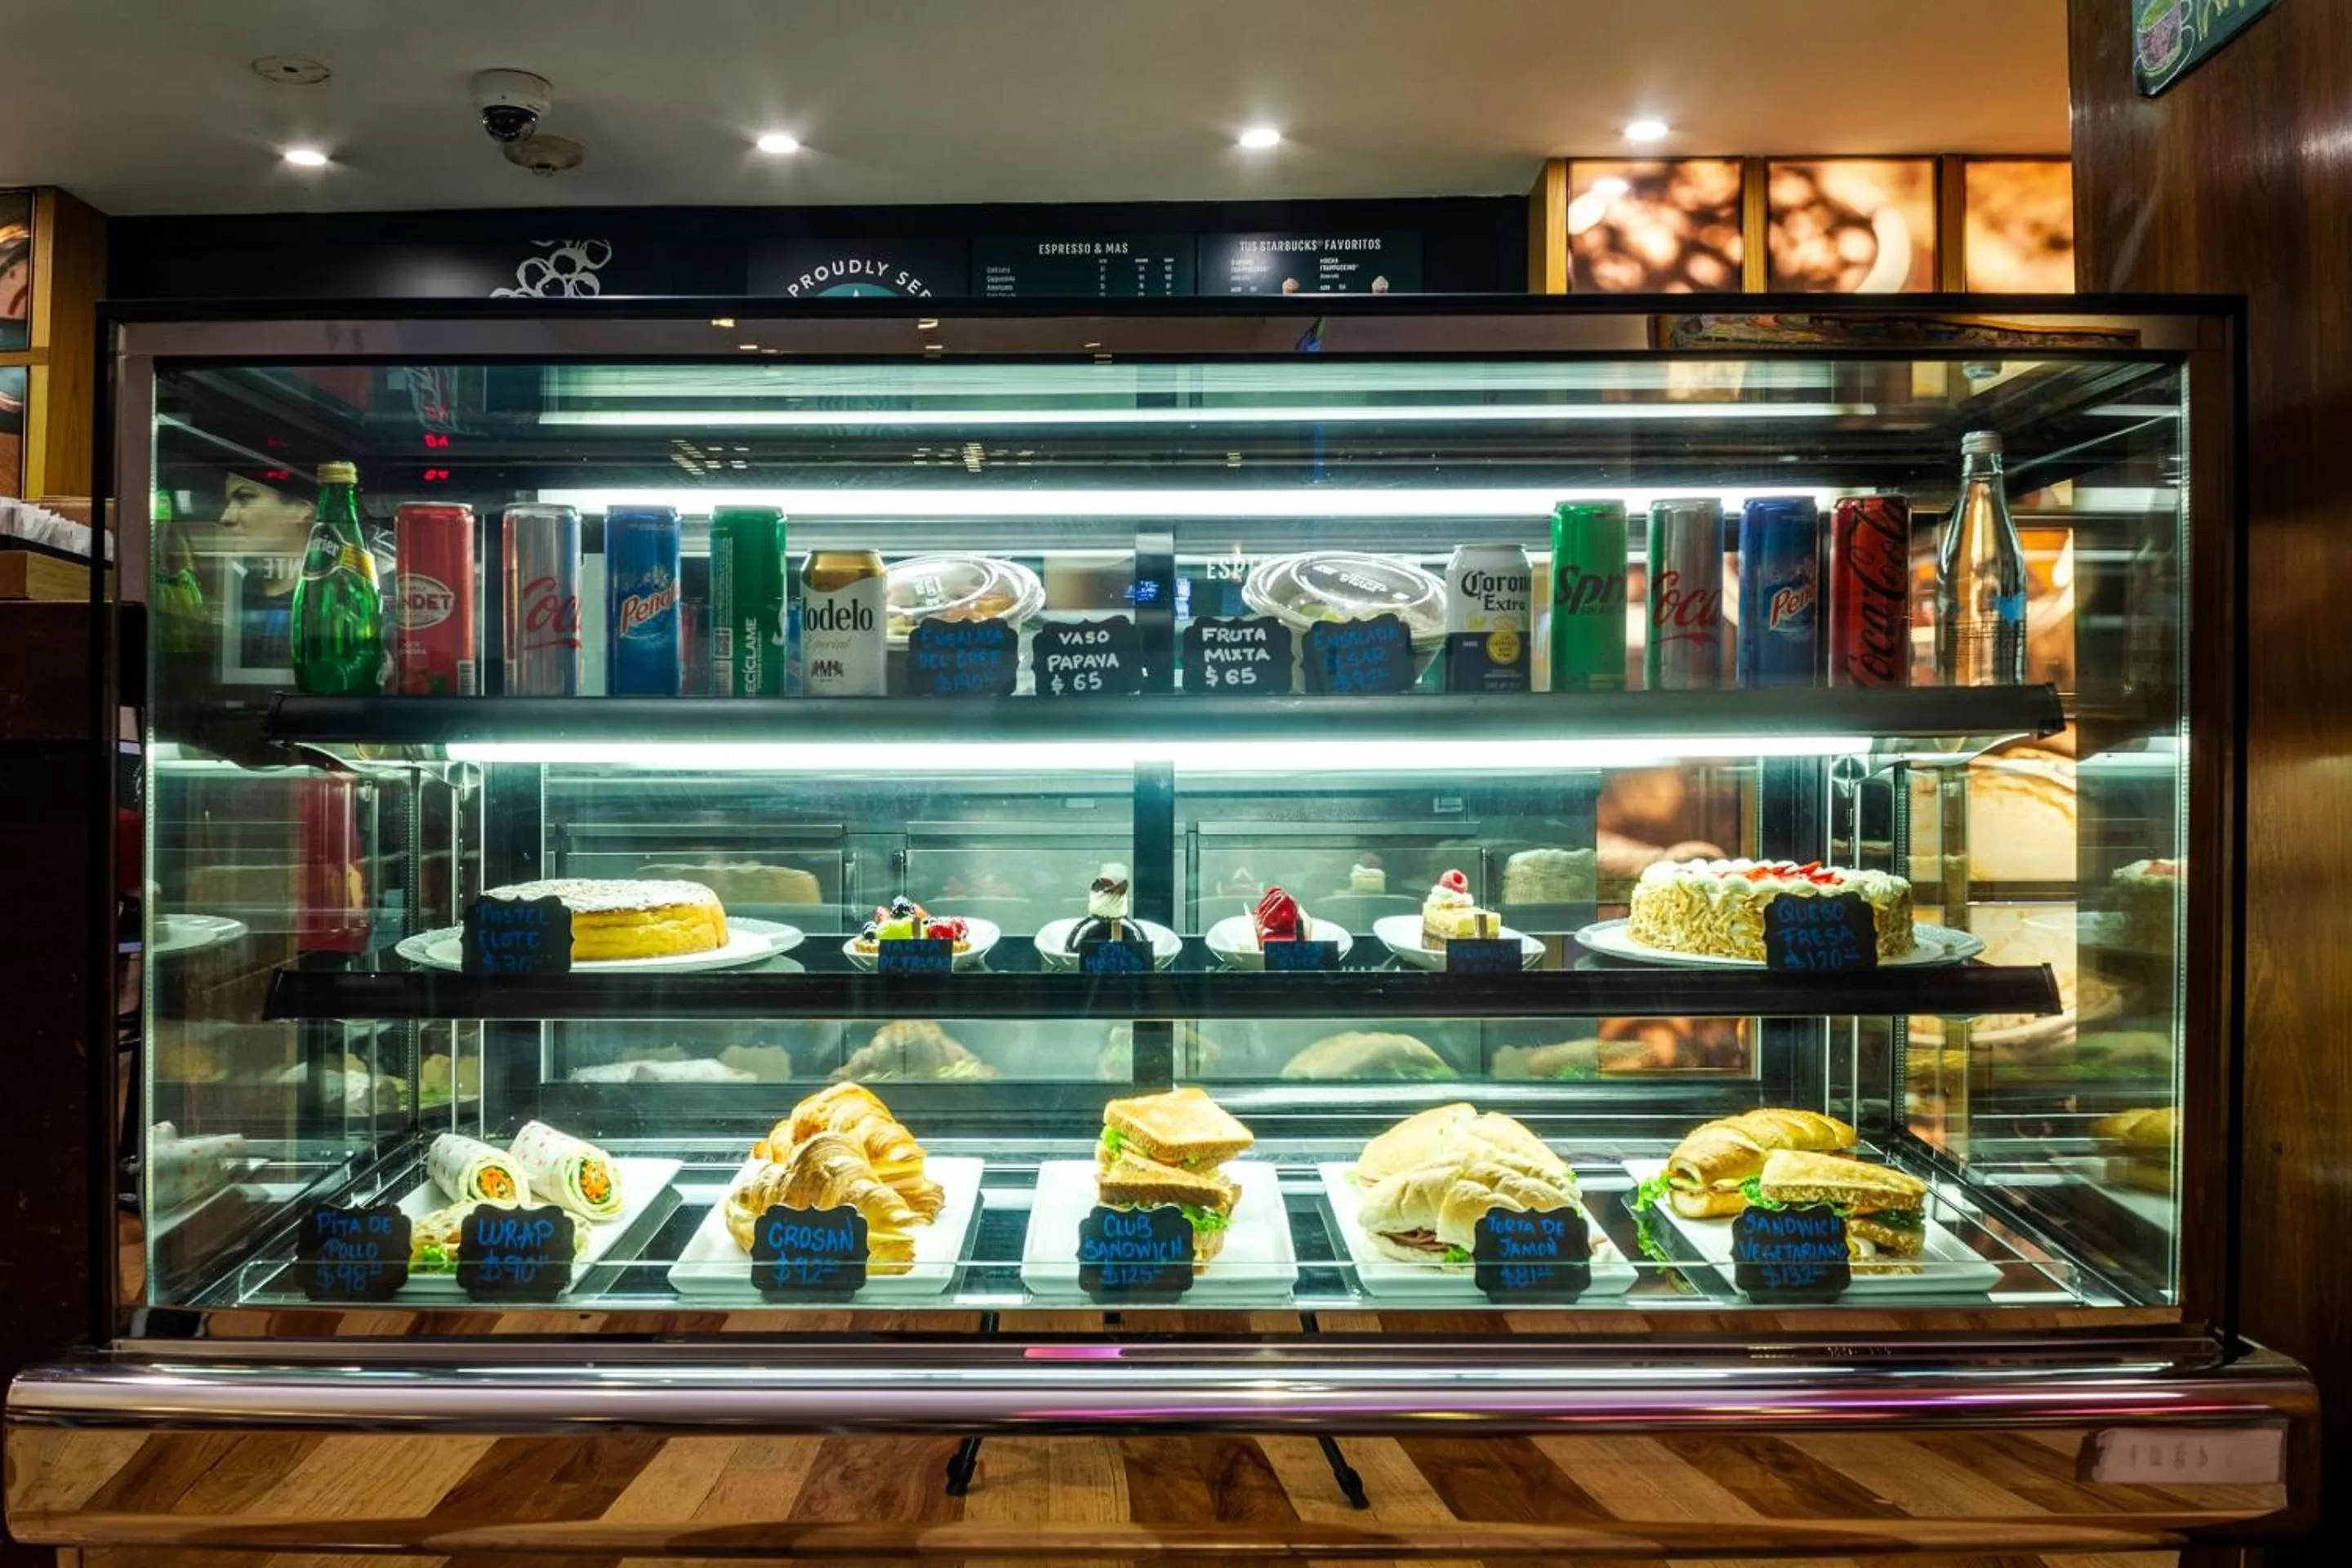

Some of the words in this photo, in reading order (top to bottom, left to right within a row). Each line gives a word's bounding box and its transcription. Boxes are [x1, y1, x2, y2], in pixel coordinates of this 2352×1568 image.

[1038, 243, 1091, 255] ESPRESSO
[1094, 243, 1102, 254] &
[1240, 241, 1257, 252] TUS
[1325, 238, 1381, 251] FAVORITOS
[788, 260, 889, 296] PROUDLY
[1059, 630, 1110, 645] VASO
[1202, 627, 1267, 643] FRUTA
[1047, 653, 1120, 673] PAPAYA
[1204, 648, 1271, 663] MIXTA
[479, 902, 551, 926] PASTEL
[1776, 897, 1845, 924] QUESO
[478, 929, 541, 950] ELOTE
[314, 1211, 363, 1236] PITA
[368, 1215, 394, 1236] DE
[477, 1215, 555, 1250] WRAP
[768, 1215, 854, 1253] CROSAN
[1103, 1213, 1154, 1238] CLUB
[1486, 1213, 1537, 1235] TORTA
[1539, 1217, 1566, 1236] DE
[1744, 1212, 1840, 1237] SANDWICH
[323, 1237, 379, 1259] POLLO
[1085, 1237, 1183, 1260] SANDWICH
[1735, 1236, 1847, 1262] VEGETARIANO
